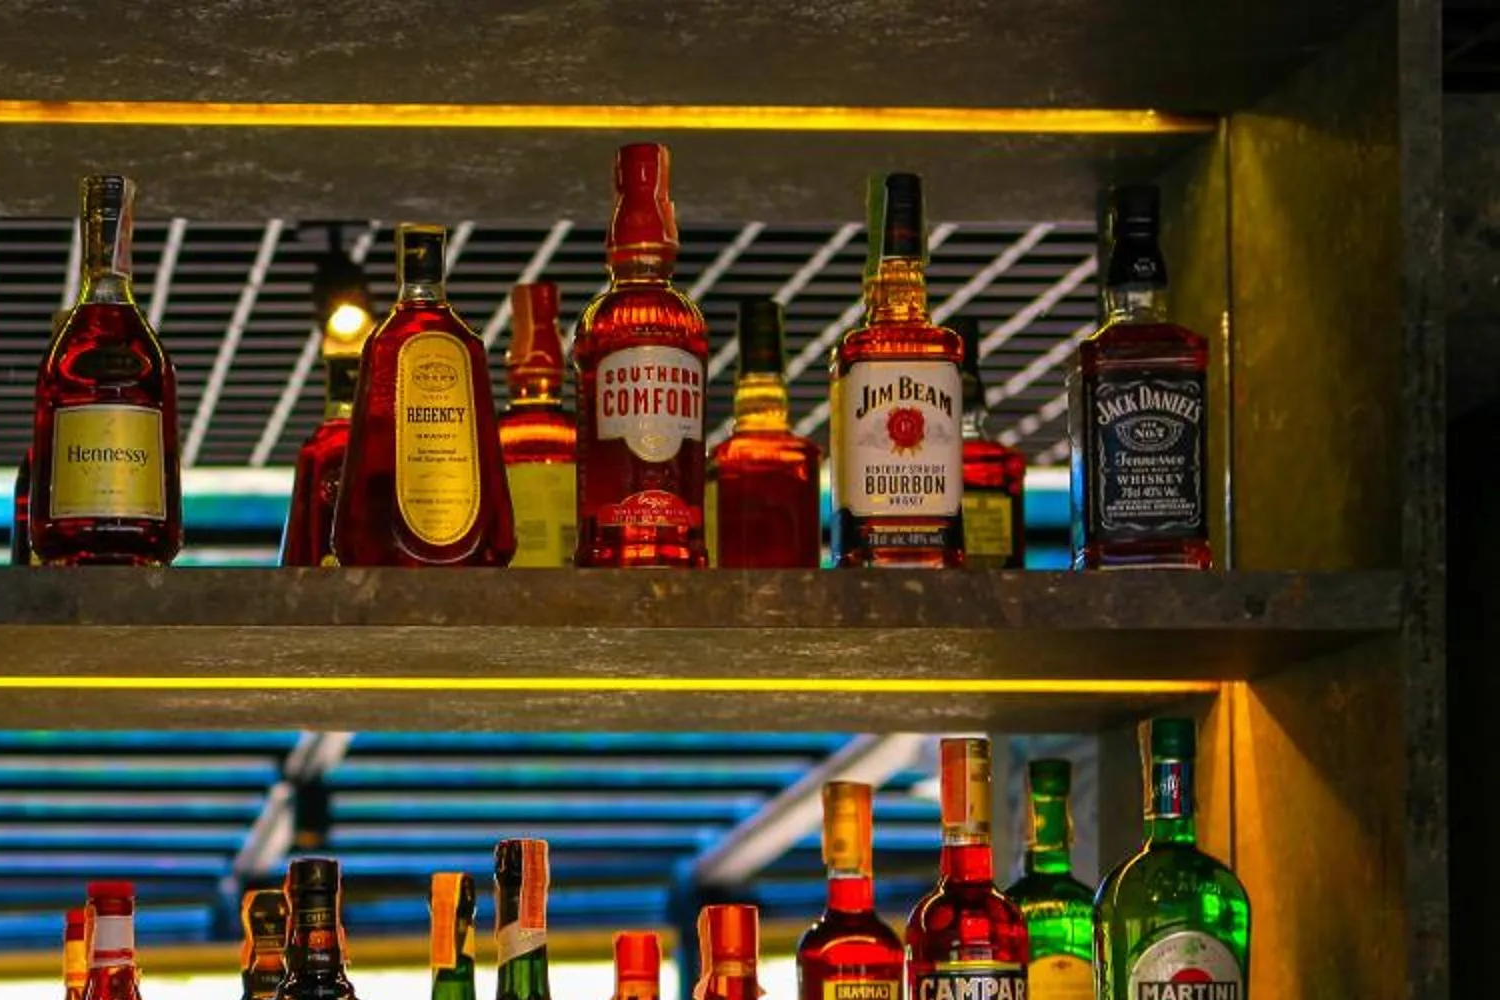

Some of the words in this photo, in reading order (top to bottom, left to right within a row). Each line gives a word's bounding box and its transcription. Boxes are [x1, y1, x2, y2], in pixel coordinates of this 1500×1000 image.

[604, 365, 700, 386] SOUTHERN
[602, 387, 701, 419] COMFORT
[855, 383, 894, 420] JIM
[898, 375, 953, 418] BEAM
[1096, 391, 1139, 425] JACK
[406, 407, 466, 424] REGENCY
[67, 443, 149, 468] Hennessy
[865, 474, 946, 495] BOURBON
[1116, 473, 1185, 485] WHISKEY
